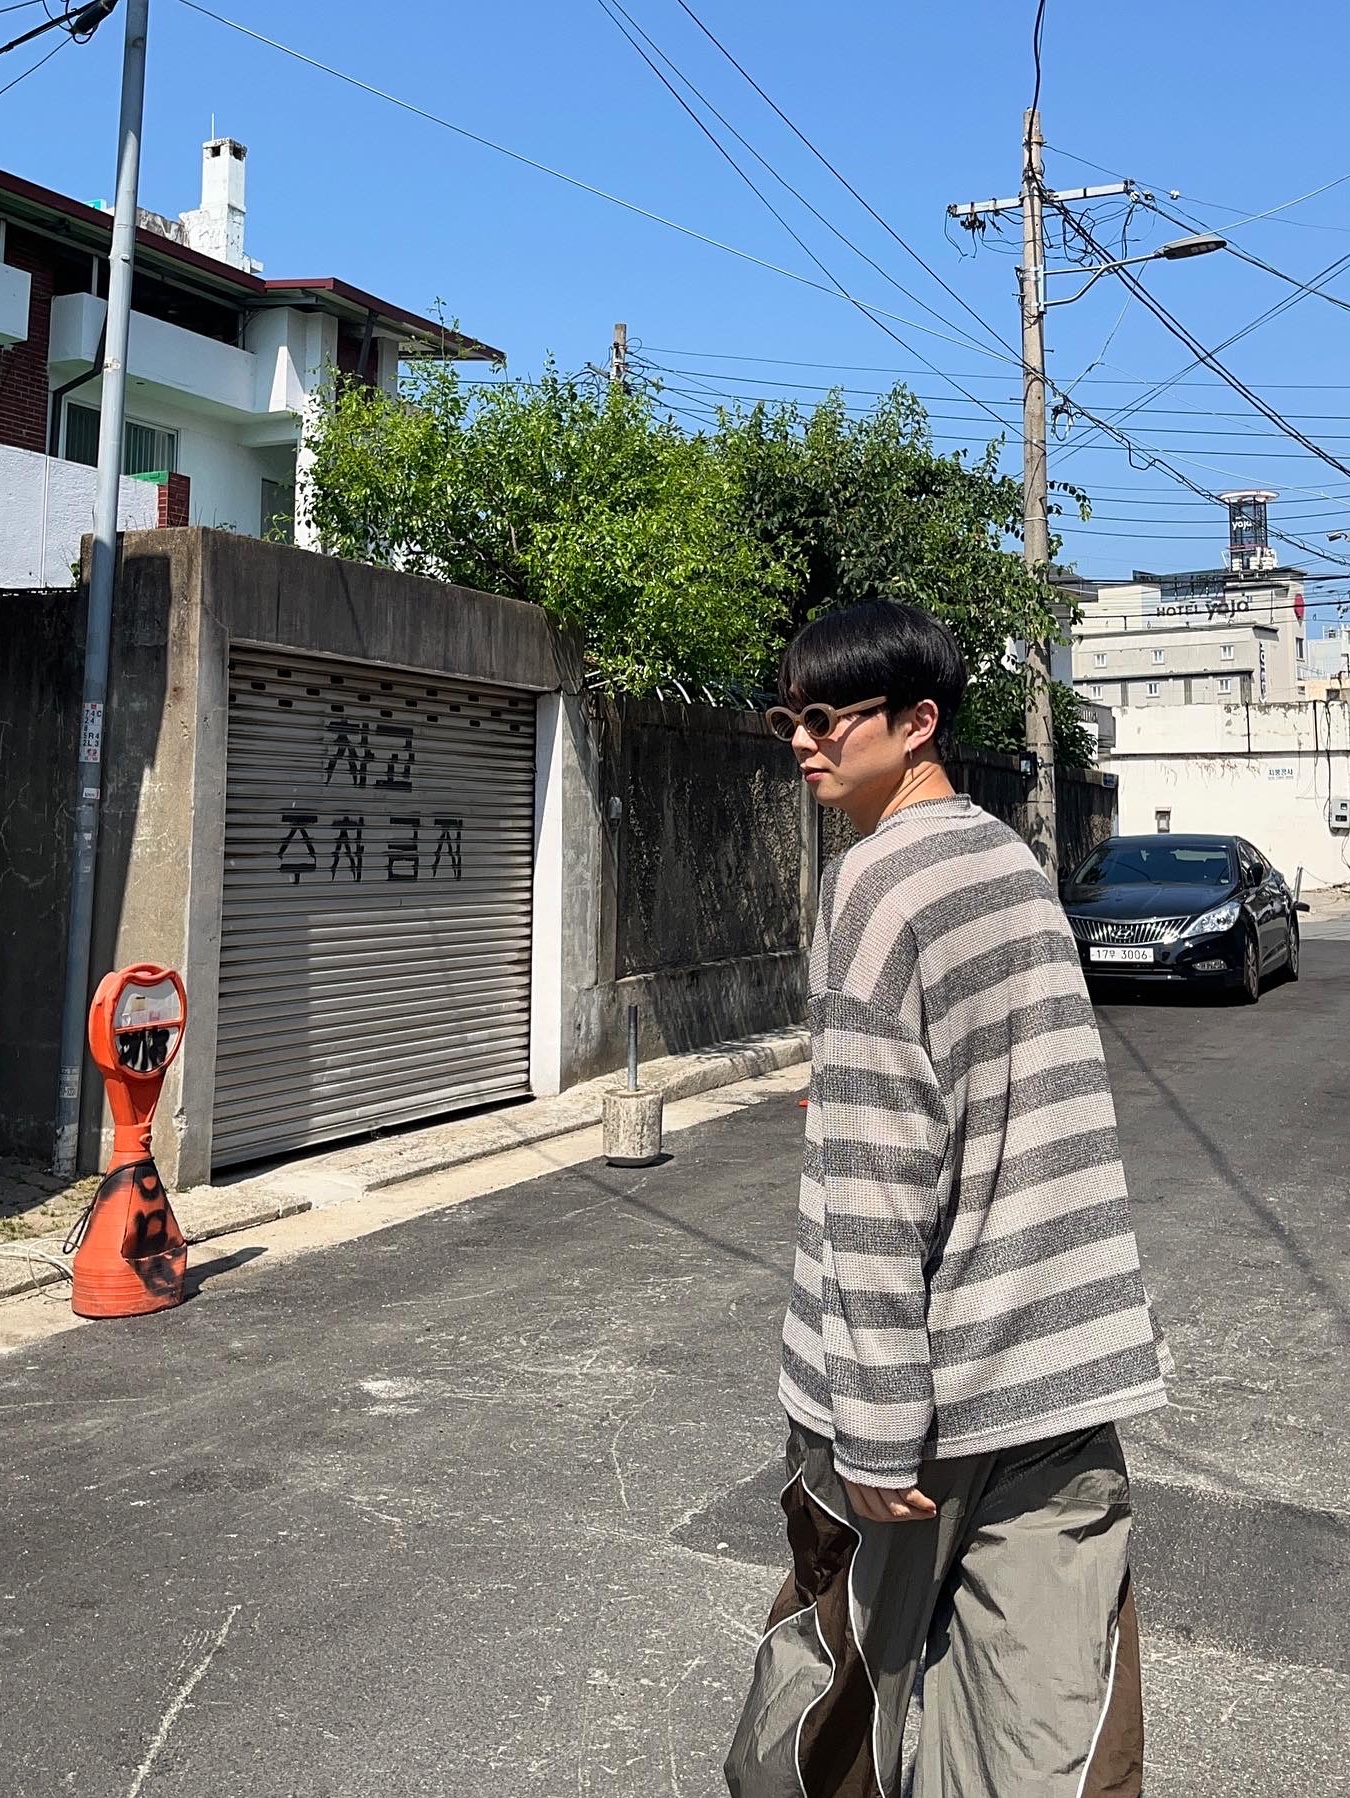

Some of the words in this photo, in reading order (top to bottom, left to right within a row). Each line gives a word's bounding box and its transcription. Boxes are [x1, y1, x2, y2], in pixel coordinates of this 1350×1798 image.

[1157, 603, 1199, 617] HOTEL
[277, 814, 463, 884] 주차금지
[1121, 949, 1148, 960] 3006
